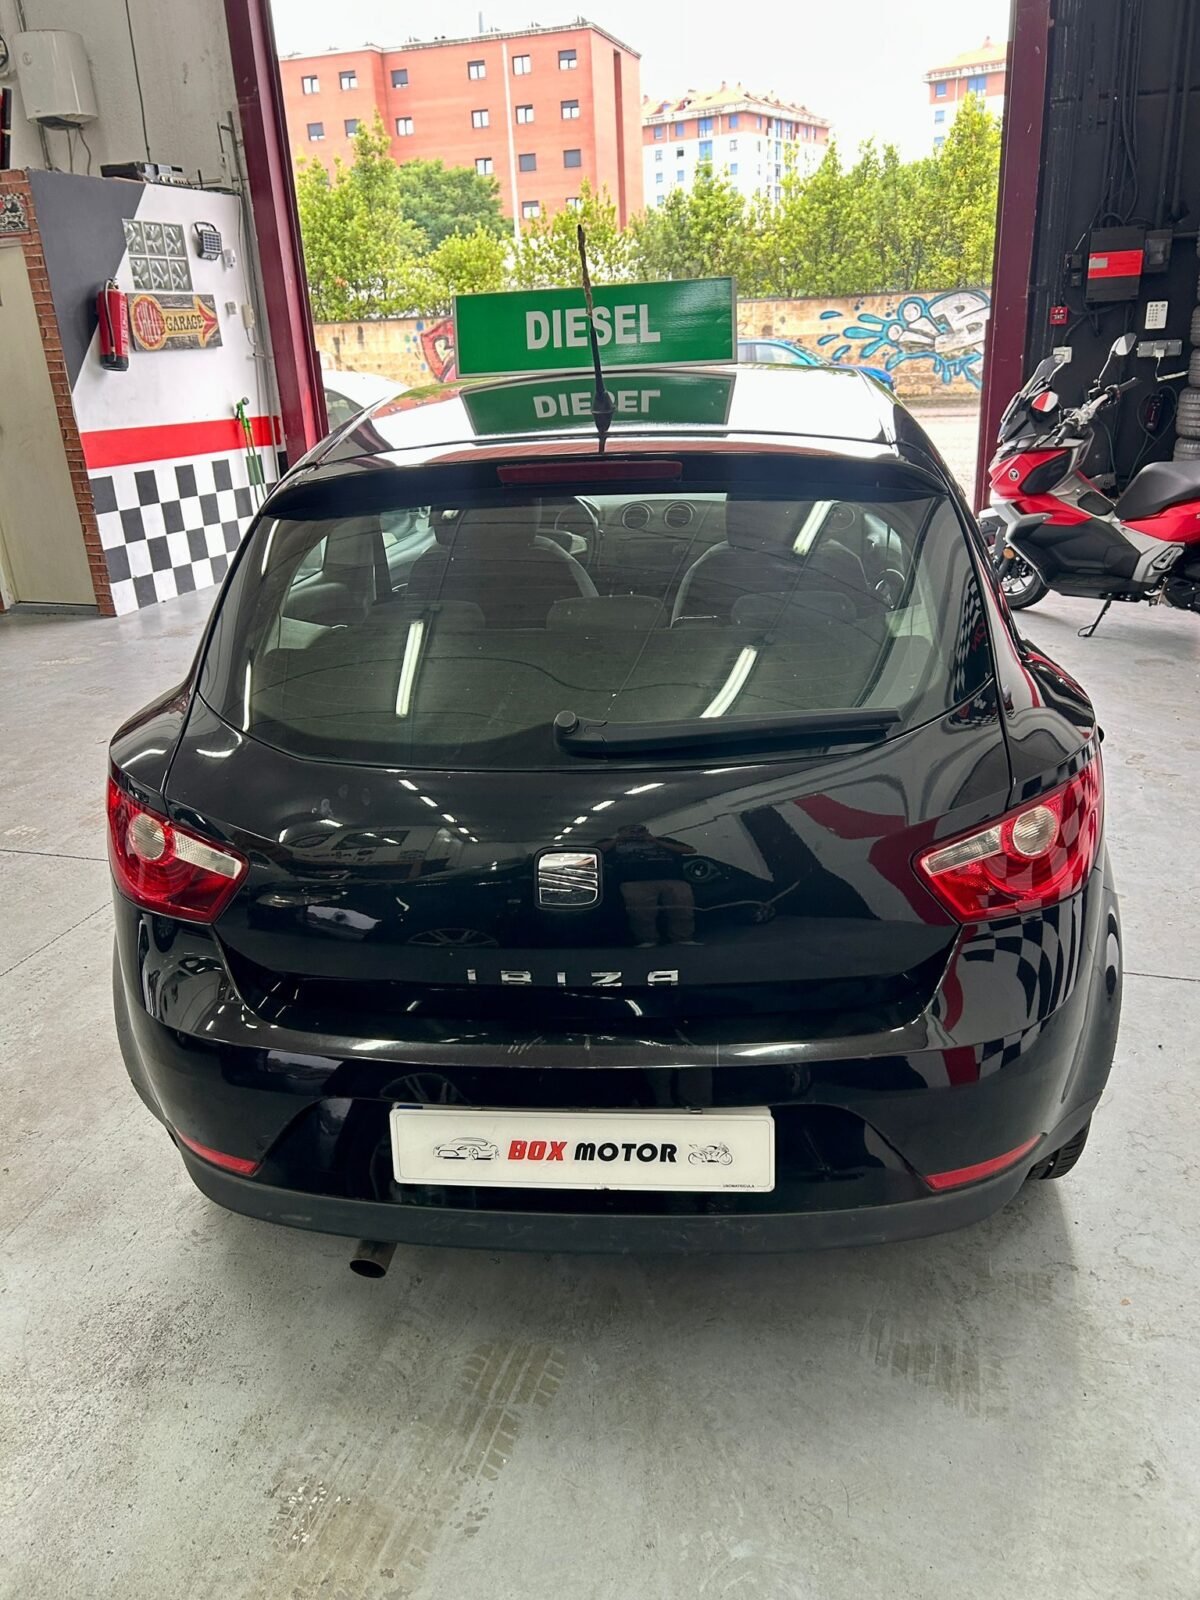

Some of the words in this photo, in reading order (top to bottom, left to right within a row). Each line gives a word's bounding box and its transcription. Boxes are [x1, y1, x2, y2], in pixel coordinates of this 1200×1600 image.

[165, 315, 204, 332] GARAGE
[526, 304, 661, 350] DIESEL
[467, 969, 679, 986] IBIZA
[508, 1140, 568, 1161] BOX
[574, 1142, 678, 1163] MOTOR
